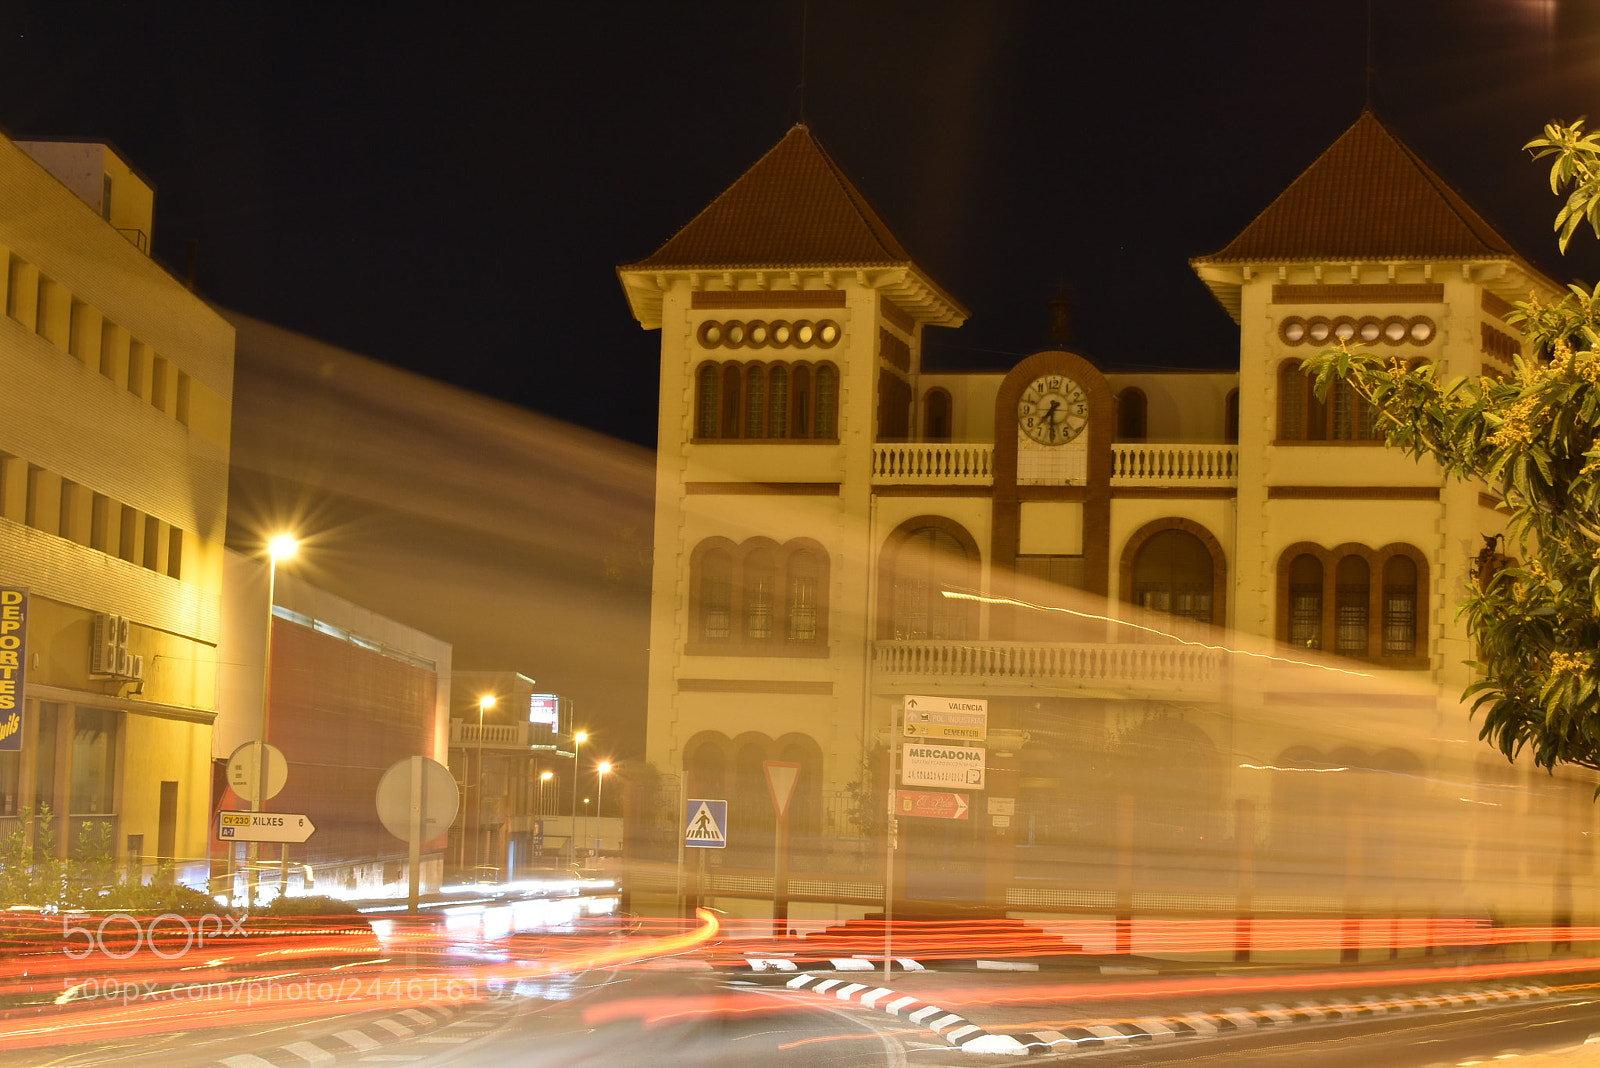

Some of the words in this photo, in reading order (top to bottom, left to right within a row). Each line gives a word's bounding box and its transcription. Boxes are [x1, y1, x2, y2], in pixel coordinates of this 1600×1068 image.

[1038, 384, 1044, 392] 11
[1048, 380, 1059, 389] 12
[1065, 383, 1069, 392] 1
[1073, 392, 1080, 402] 2
[1023, 405, 1030, 414] 9
[1077, 405, 1084, 414] 3
[1027, 418, 1034, 427] 8
[1036, 427, 1042, 436] 7
[1063, 427, 1068, 437] 5
[0, 591, 22, 710] DEPORTES
[948, 702, 983, 712] VALENCIA
[0, 713, 20, 741] uils
[943, 728, 979, 737] CEMENTERI
[909, 748, 980, 760] MERCADONA
[223, 816, 249, 825] CV-230
[252, 817, 284, 826] XILXES
[298, 819, 304, 827] 6
